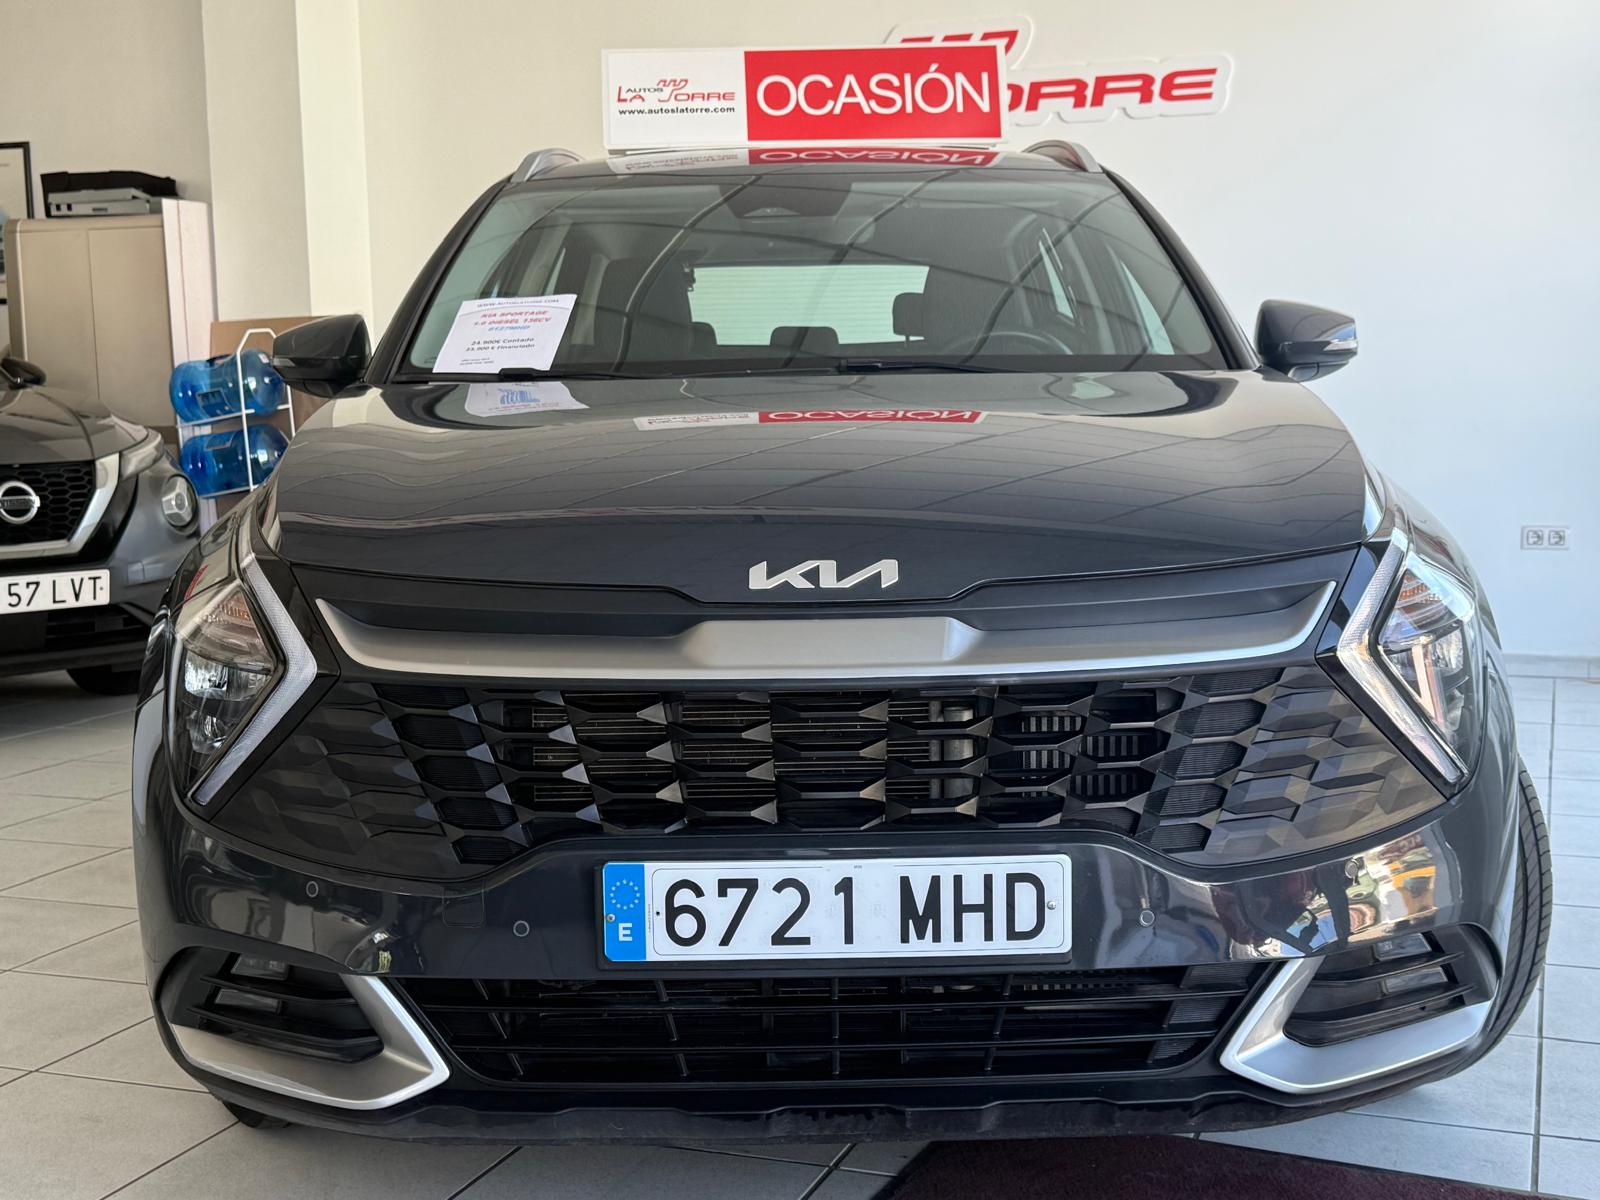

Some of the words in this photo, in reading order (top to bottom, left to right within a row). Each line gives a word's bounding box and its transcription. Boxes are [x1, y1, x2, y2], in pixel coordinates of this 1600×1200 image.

[616, 86, 646, 102] LA
[756, 63, 991, 117] OCASIÓN
[618, 106, 736, 115] www.autoslatorre.com
[749, 559, 899, 589] KIA
[53, 576, 102, 604] LVT
[664, 876, 854, 947] 6721
[899, 872, 1046, 944] MHD
[618, 923, 633, 942] E
